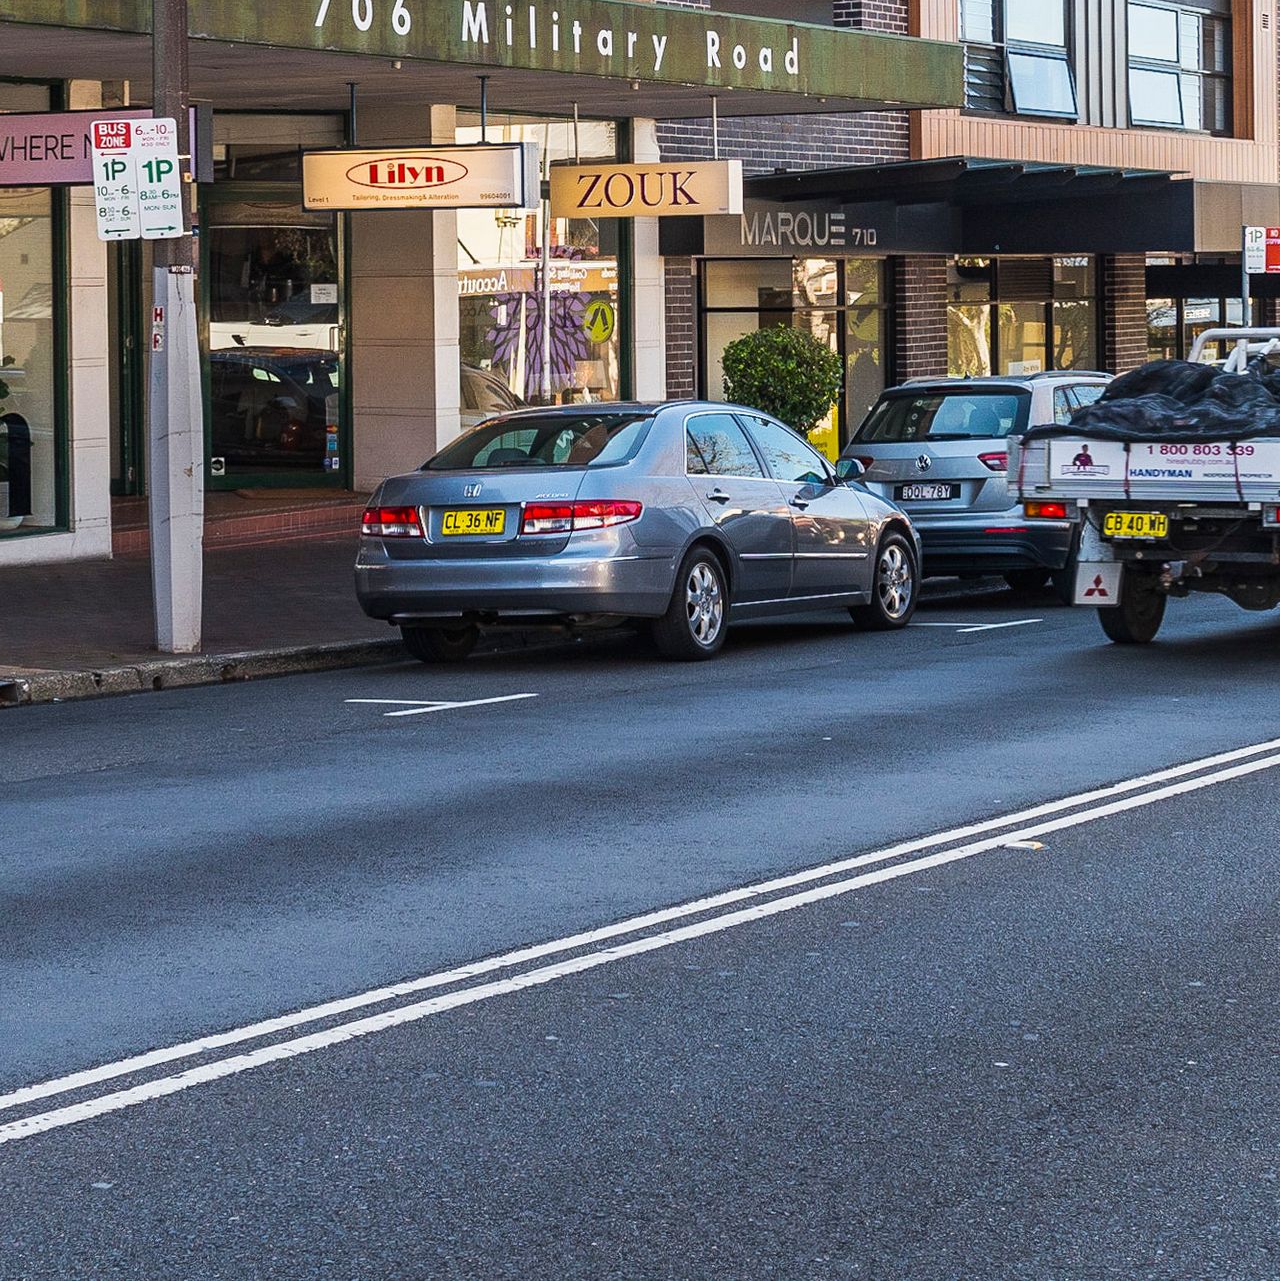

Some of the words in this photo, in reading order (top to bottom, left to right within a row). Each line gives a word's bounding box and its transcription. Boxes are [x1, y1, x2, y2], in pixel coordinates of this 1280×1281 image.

[461, 0, 668, 71] Military
[706, 29, 799, 75] Road
[98, 123, 126, 135] BUS
[100, 136, 127, 148] ZONE
[102, 160, 127, 181] 1P
[142, 159, 174, 183] 1P
[369, 163, 445, 185] Lilyn
[577, 171, 700, 209] ZOUK
[740, 212, 846, 246] MARQUE
[852, 229, 877, 246] 710
[1146, 445, 1154, 455] 1
[1159, 444, 1189, 456] 800
[1193, 444, 1221, 456] 803
[1130, 468, 1193, 478] HANDYMAN
